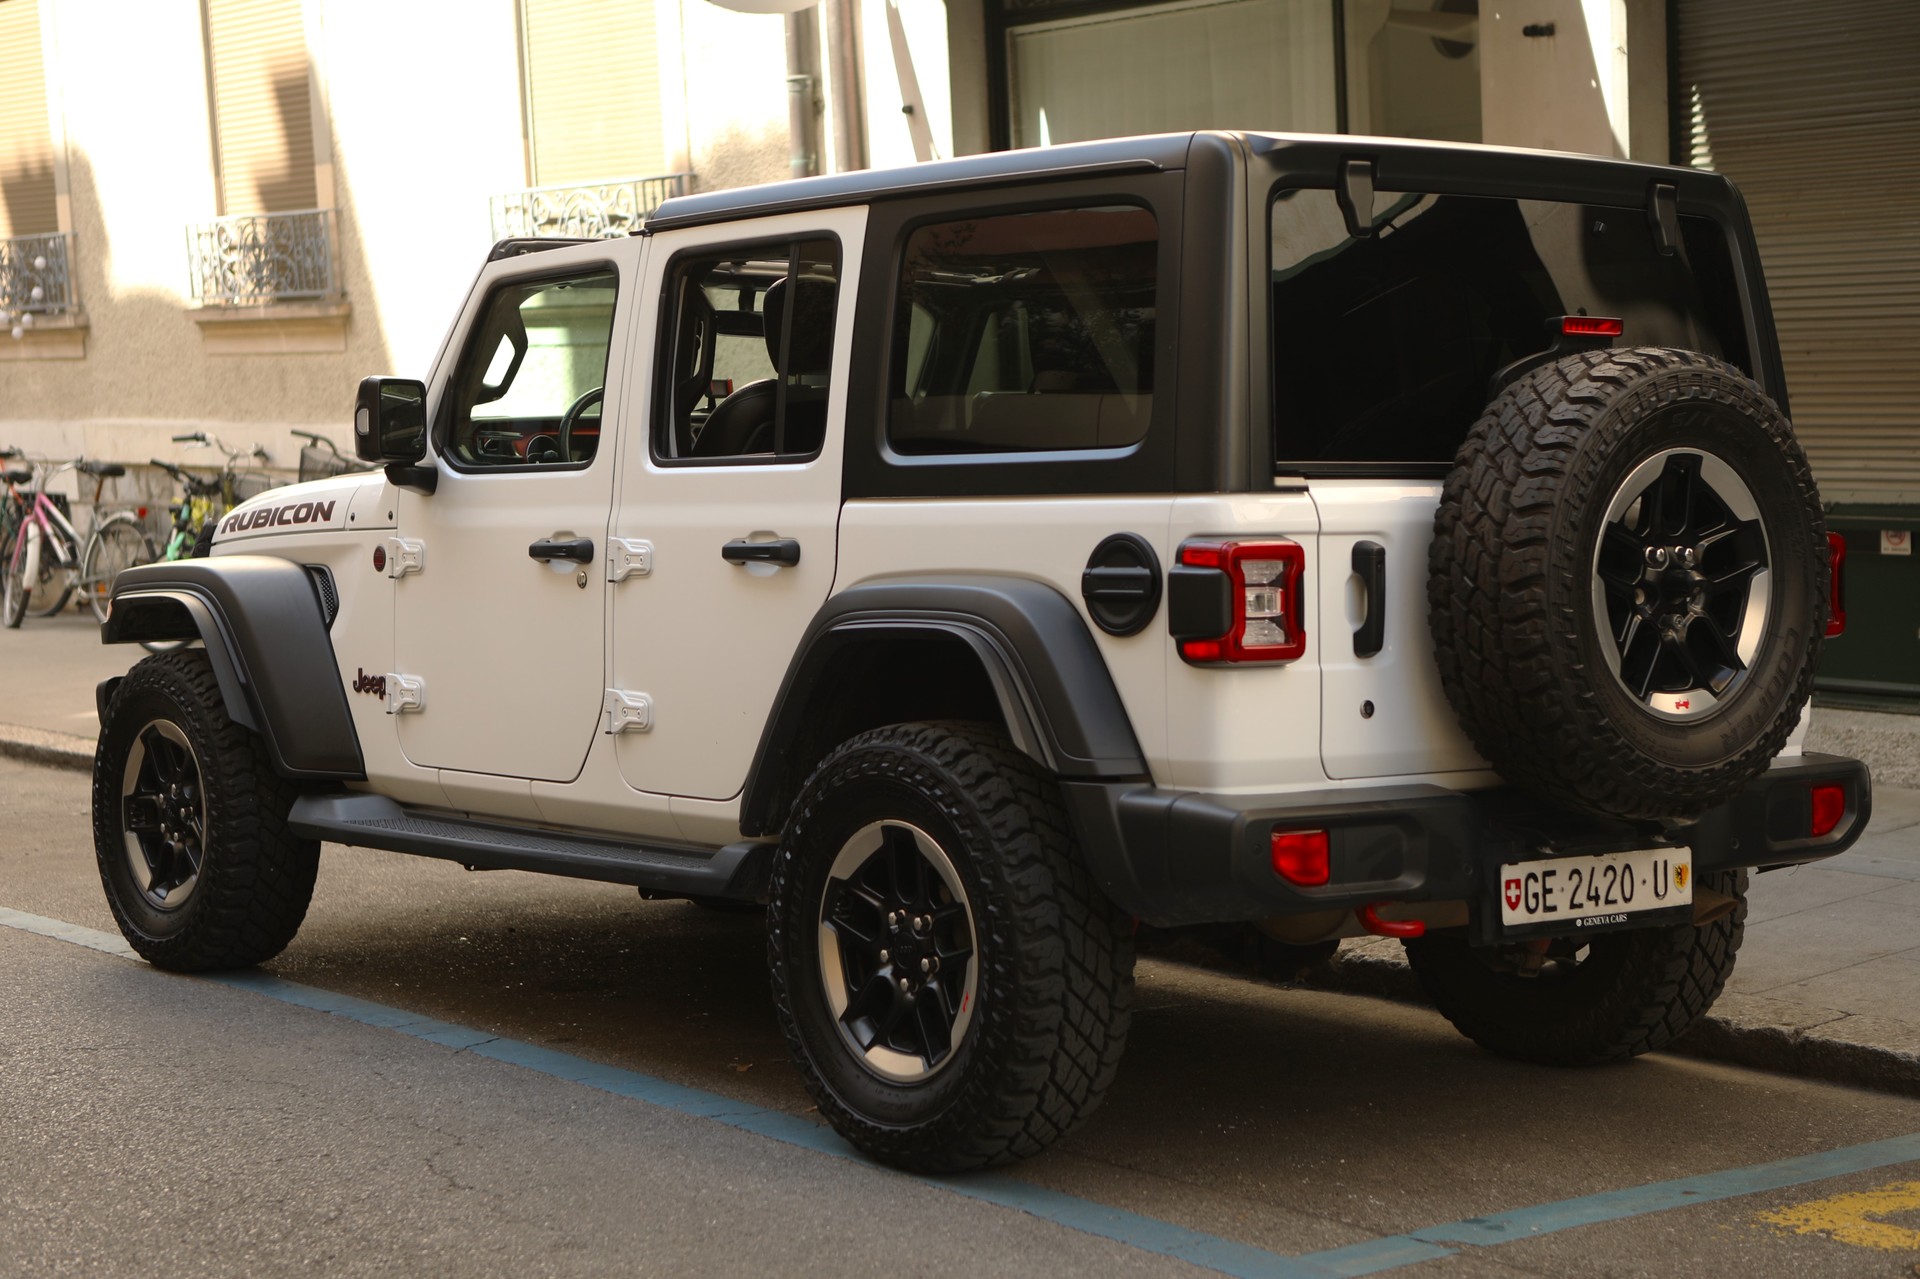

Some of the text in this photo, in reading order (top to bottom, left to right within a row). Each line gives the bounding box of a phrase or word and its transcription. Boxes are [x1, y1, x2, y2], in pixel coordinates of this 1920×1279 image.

[220, 500, 336, 534] RUBICON
[352, 667, 386, 700] Jeep
[1583, 913, 1628, 927] GENEVA CARS
